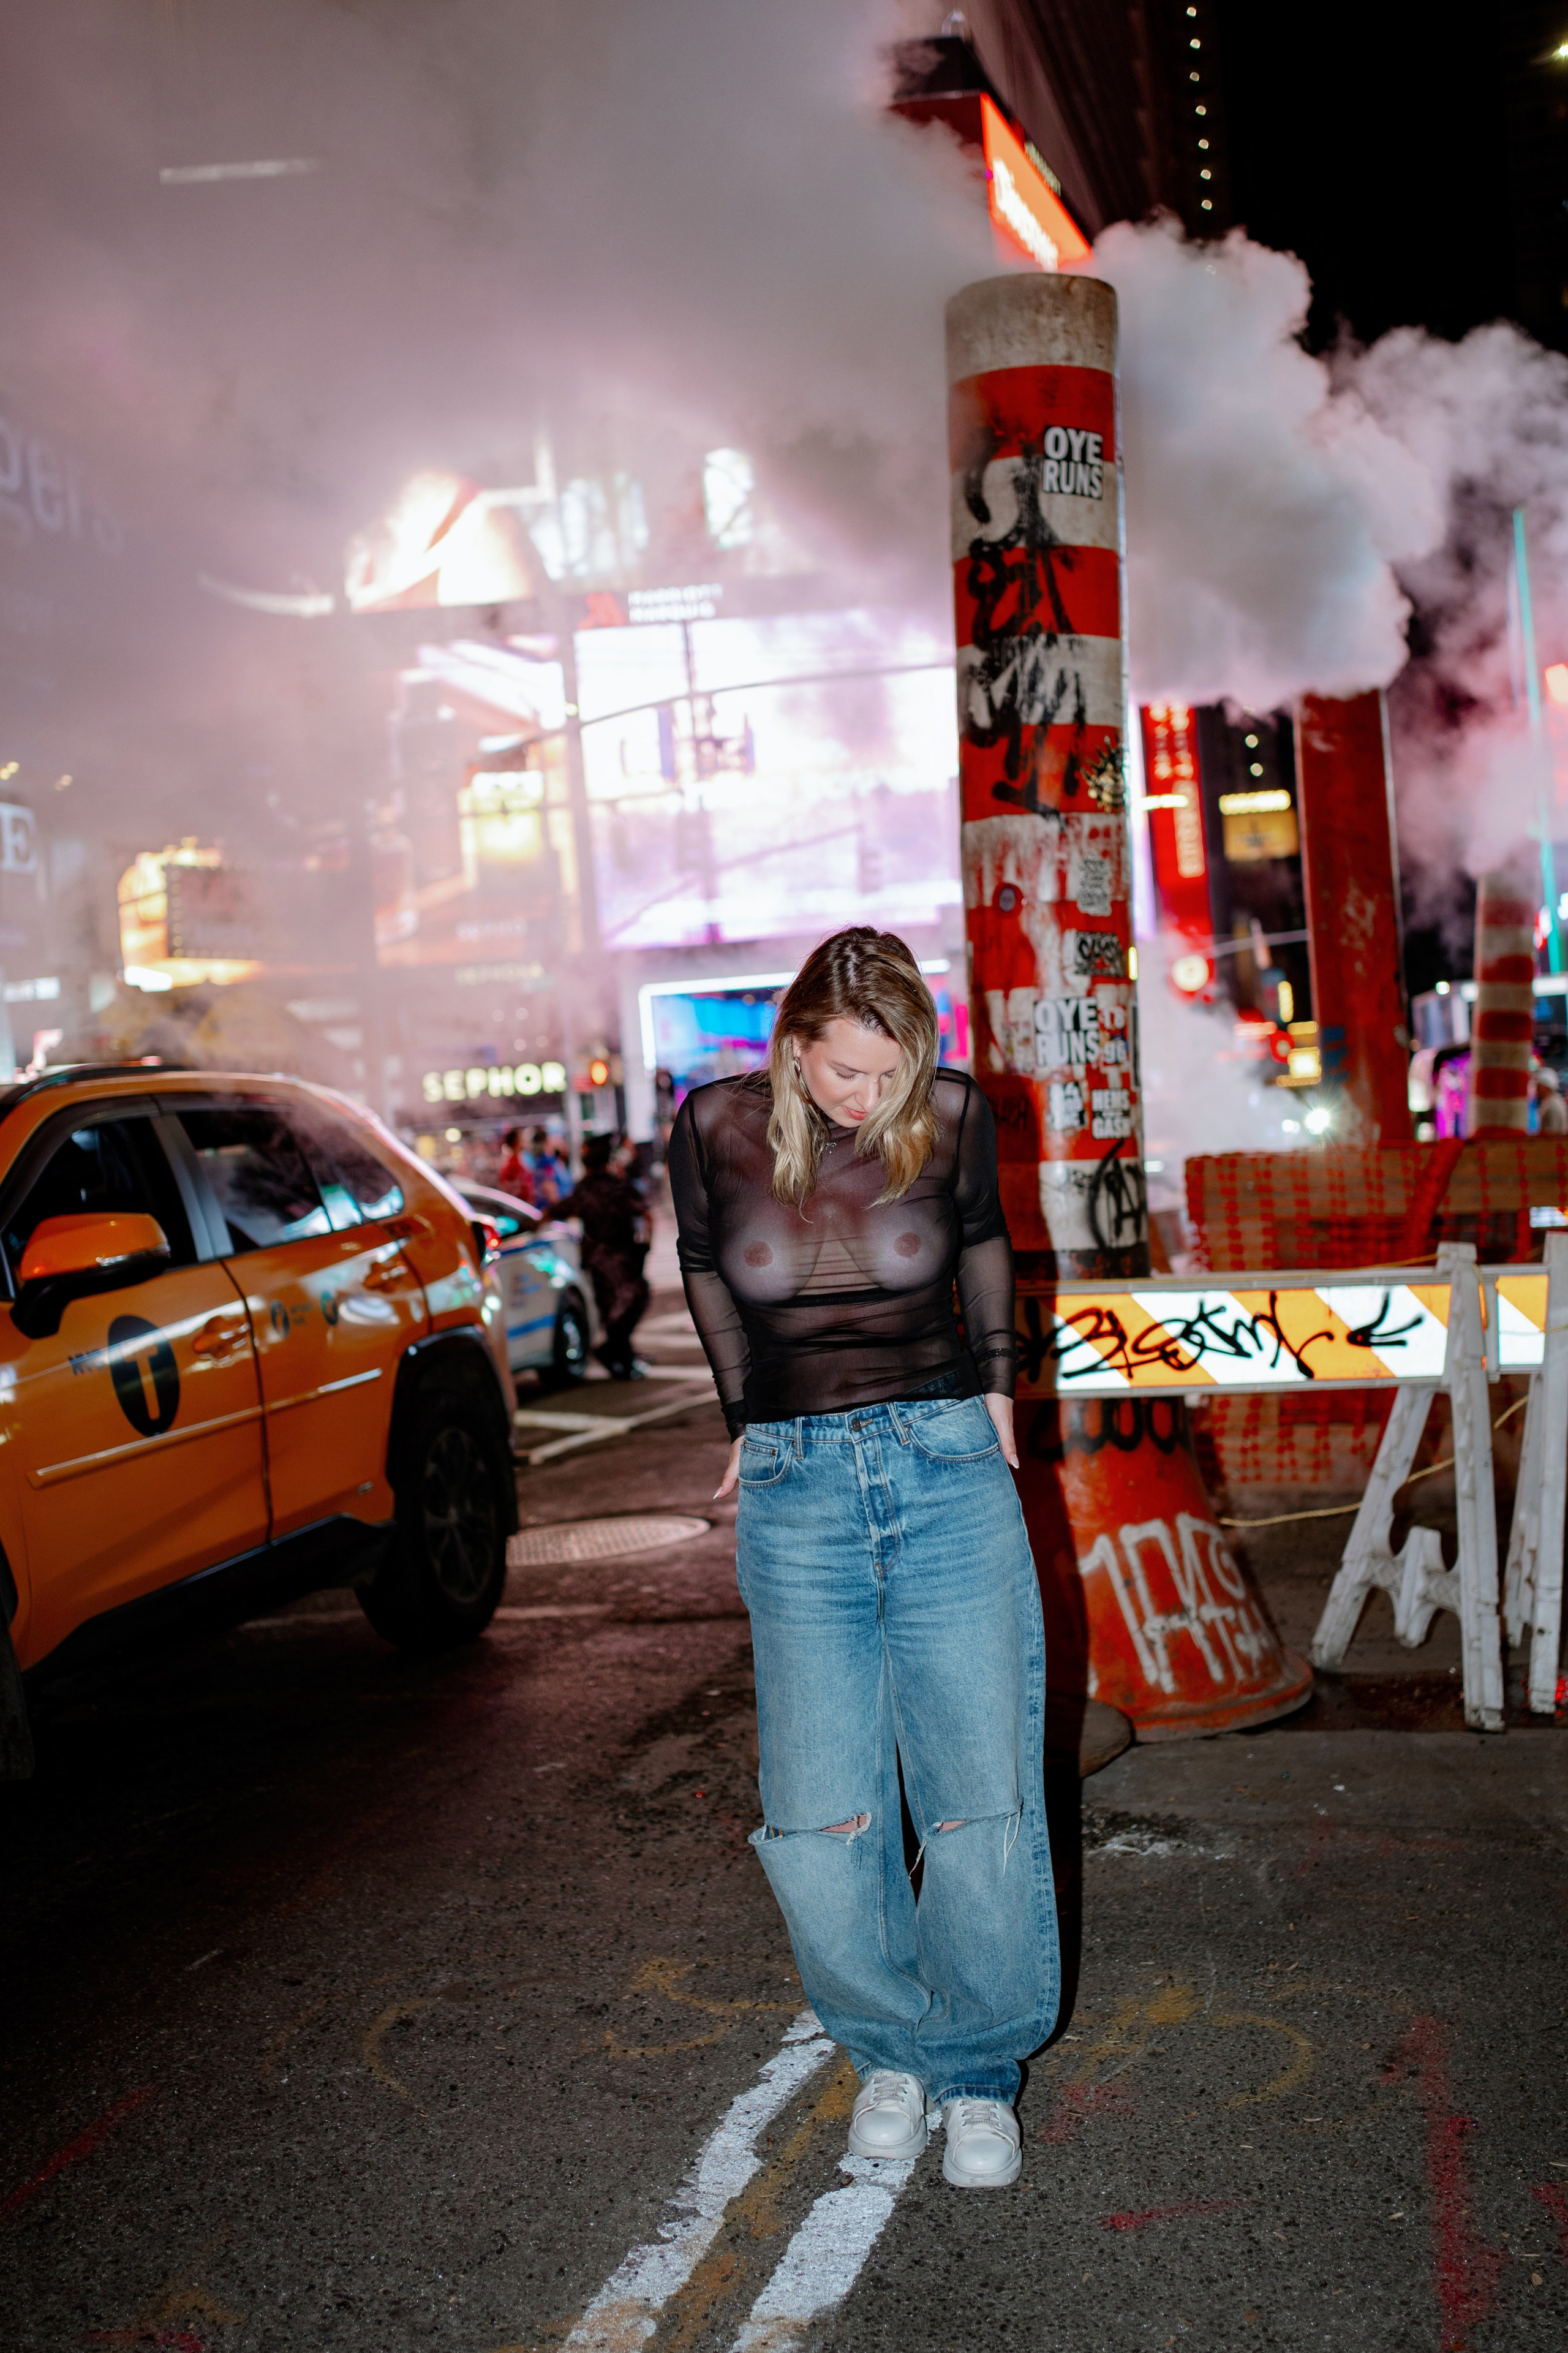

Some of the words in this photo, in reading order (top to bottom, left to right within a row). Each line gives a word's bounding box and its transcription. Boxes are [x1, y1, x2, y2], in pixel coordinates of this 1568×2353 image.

[1044, 426, 1103, 466] OYE
[1042, 459, 1103, 498] RUNS
[1034, 998, 1099, 1032] OYE
[1036, 1030, 1100, 1067] RUNS
[422, 1062, 567, 1103] SEPHOR
